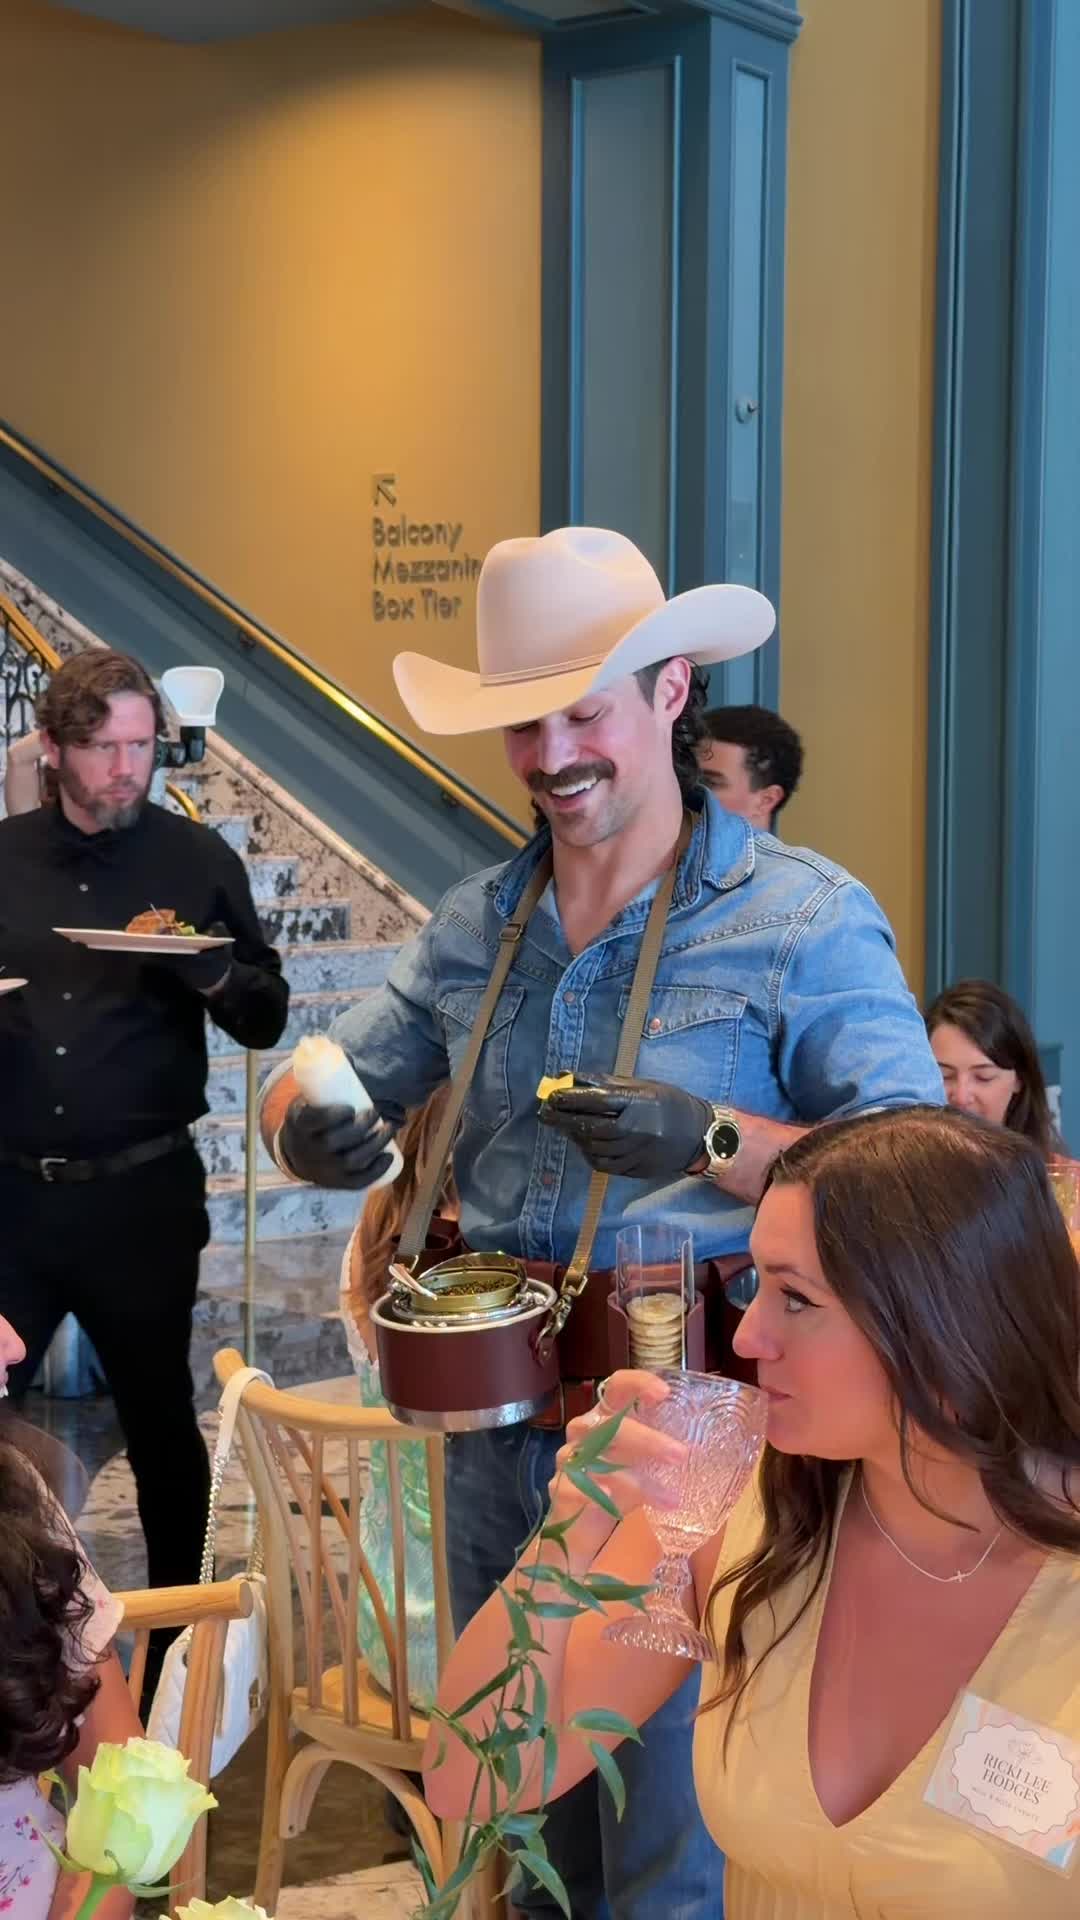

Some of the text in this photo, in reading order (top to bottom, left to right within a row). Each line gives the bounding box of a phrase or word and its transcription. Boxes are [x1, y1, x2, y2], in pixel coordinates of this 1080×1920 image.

[373, 514, 463, 552] Balcony
[373, 553, 482, 584] Mezzanin
[372, 588, 462, 622] Box Tier
[983, 1752, 1049, 1793] RICKI LEE
[983, 1768, 1040, 1804] HODGES
